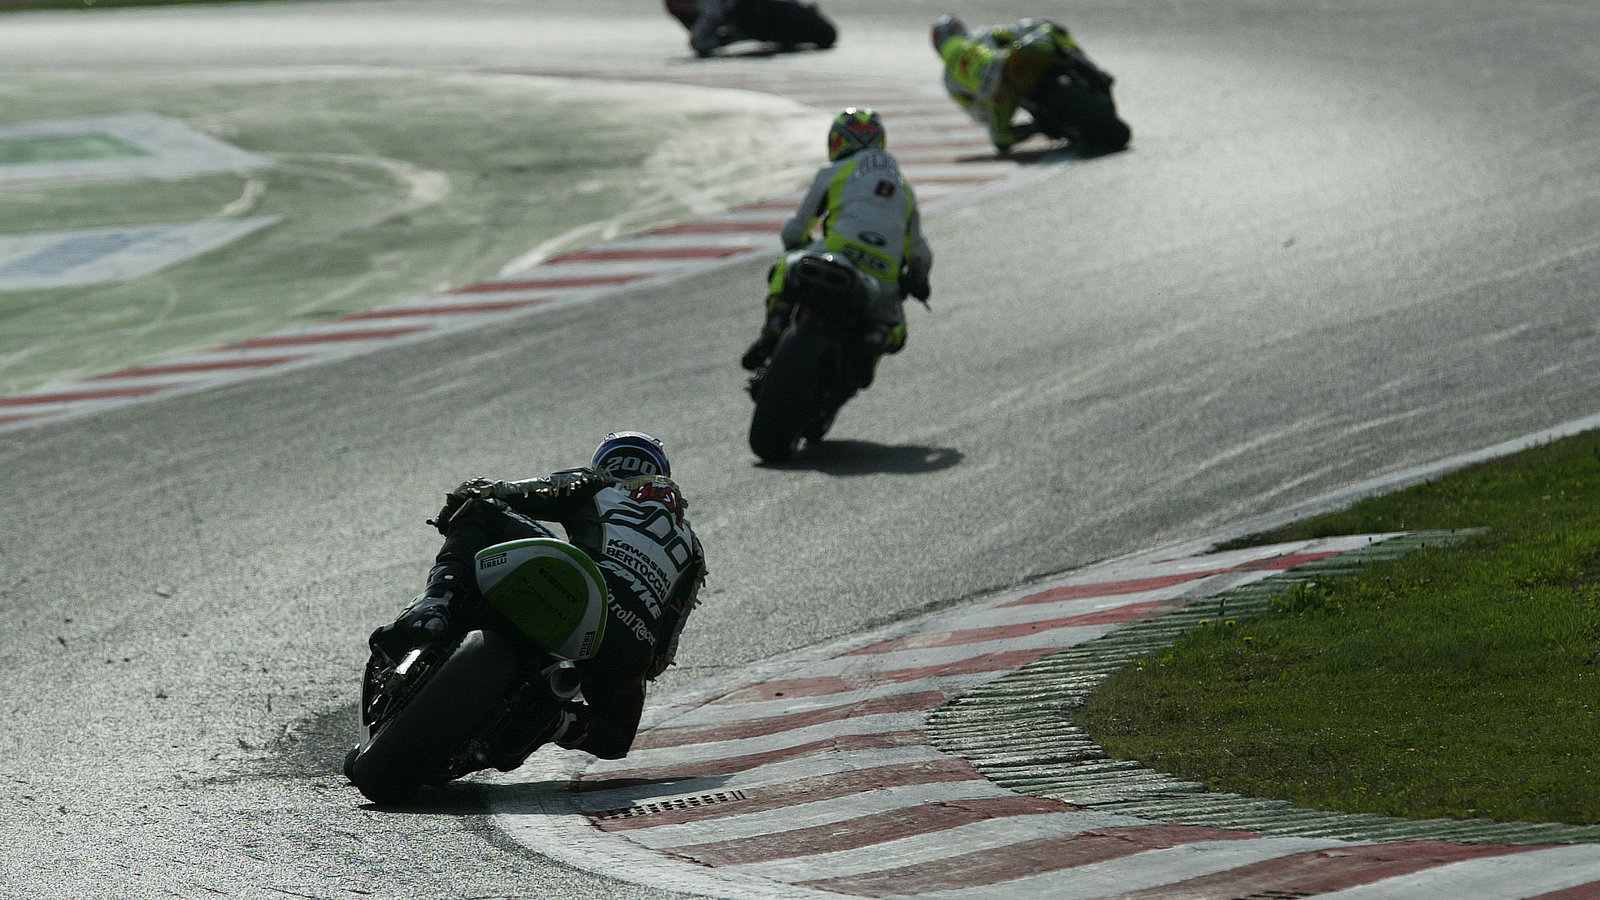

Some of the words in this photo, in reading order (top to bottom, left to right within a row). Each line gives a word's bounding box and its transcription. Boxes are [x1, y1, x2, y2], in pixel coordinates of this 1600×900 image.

[603, 456, 657, 479] 200
[480, 552, 508, 570] PIRELLI
[600, 500, 693, 574] 200
[596, 560, 662, 620] SPYKE
[605, 547, 667, 602] BERTOCCHI
[607, 538, 672, 592] Kawasaki
[610, 603, 637, 626] roll
